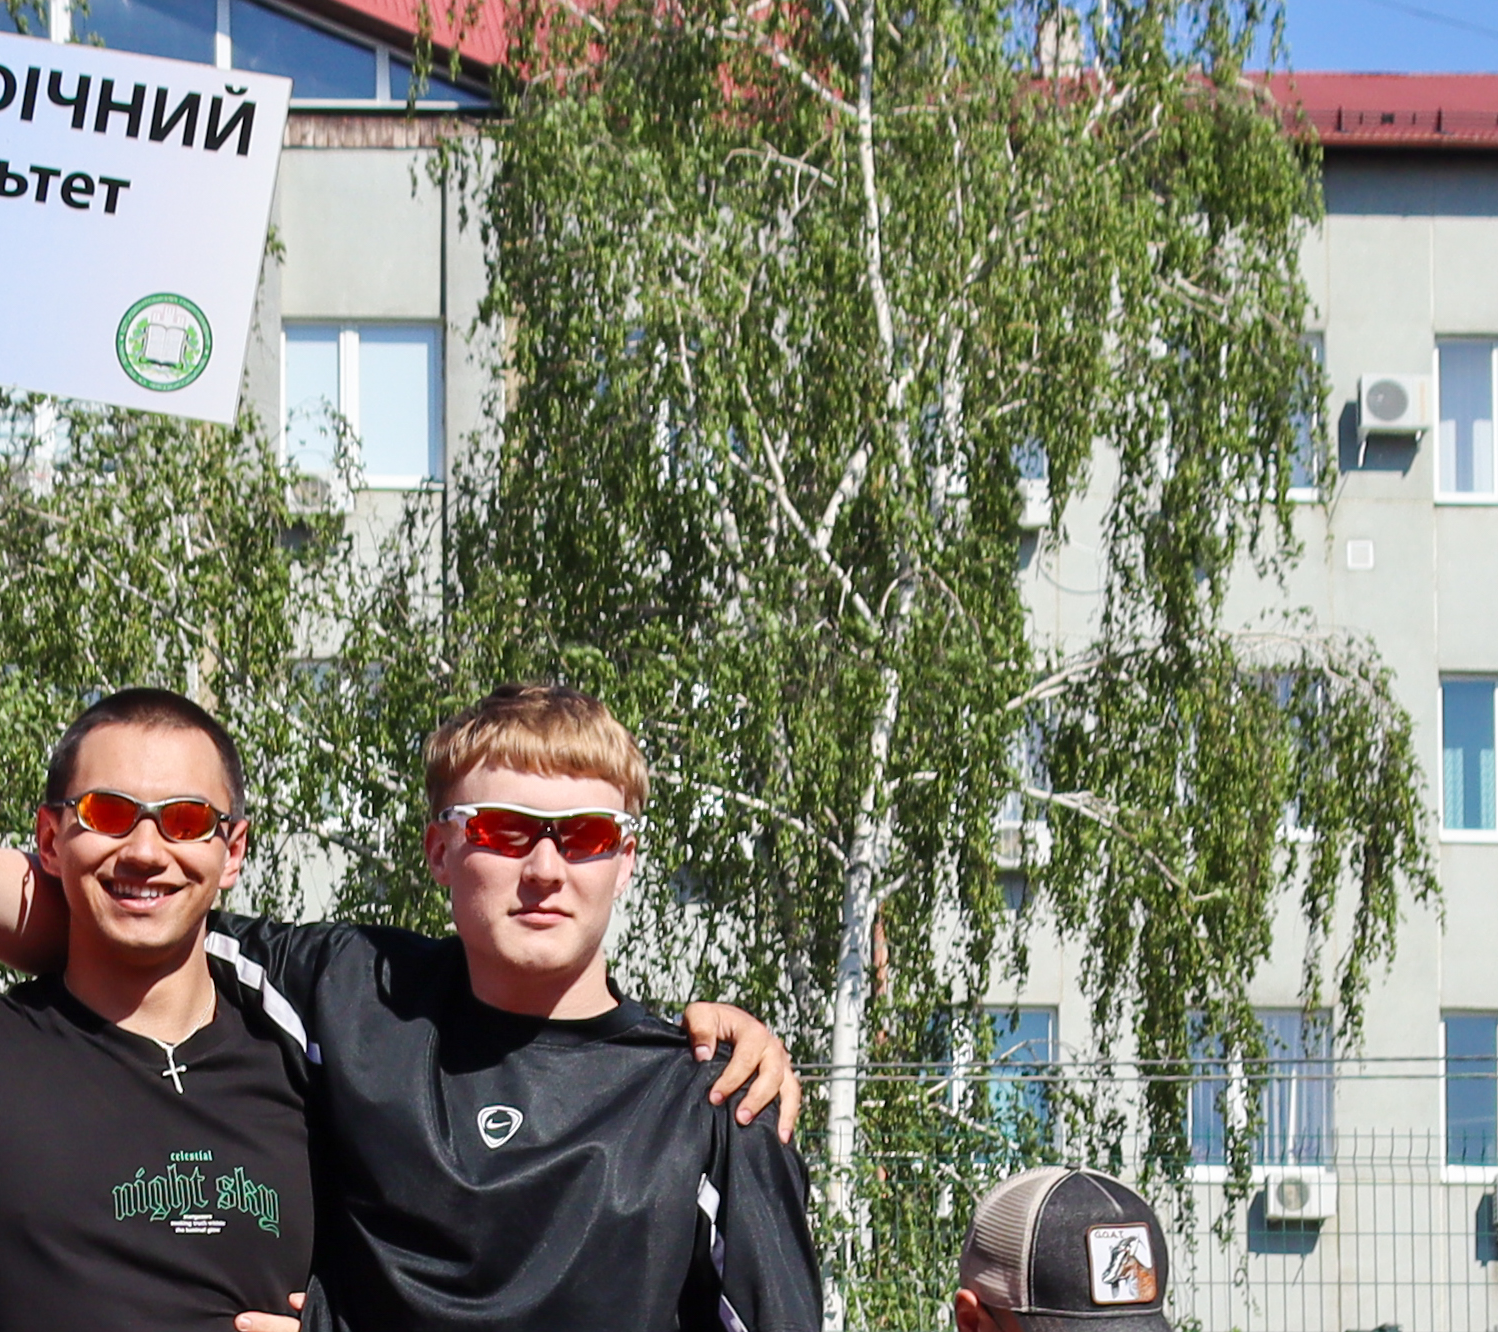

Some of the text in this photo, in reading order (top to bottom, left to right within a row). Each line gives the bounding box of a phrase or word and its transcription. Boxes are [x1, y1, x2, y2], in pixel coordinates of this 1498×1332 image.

[170, 1150, 213, 1162] celestial
[112, 1163, 280, 1239] night sky
